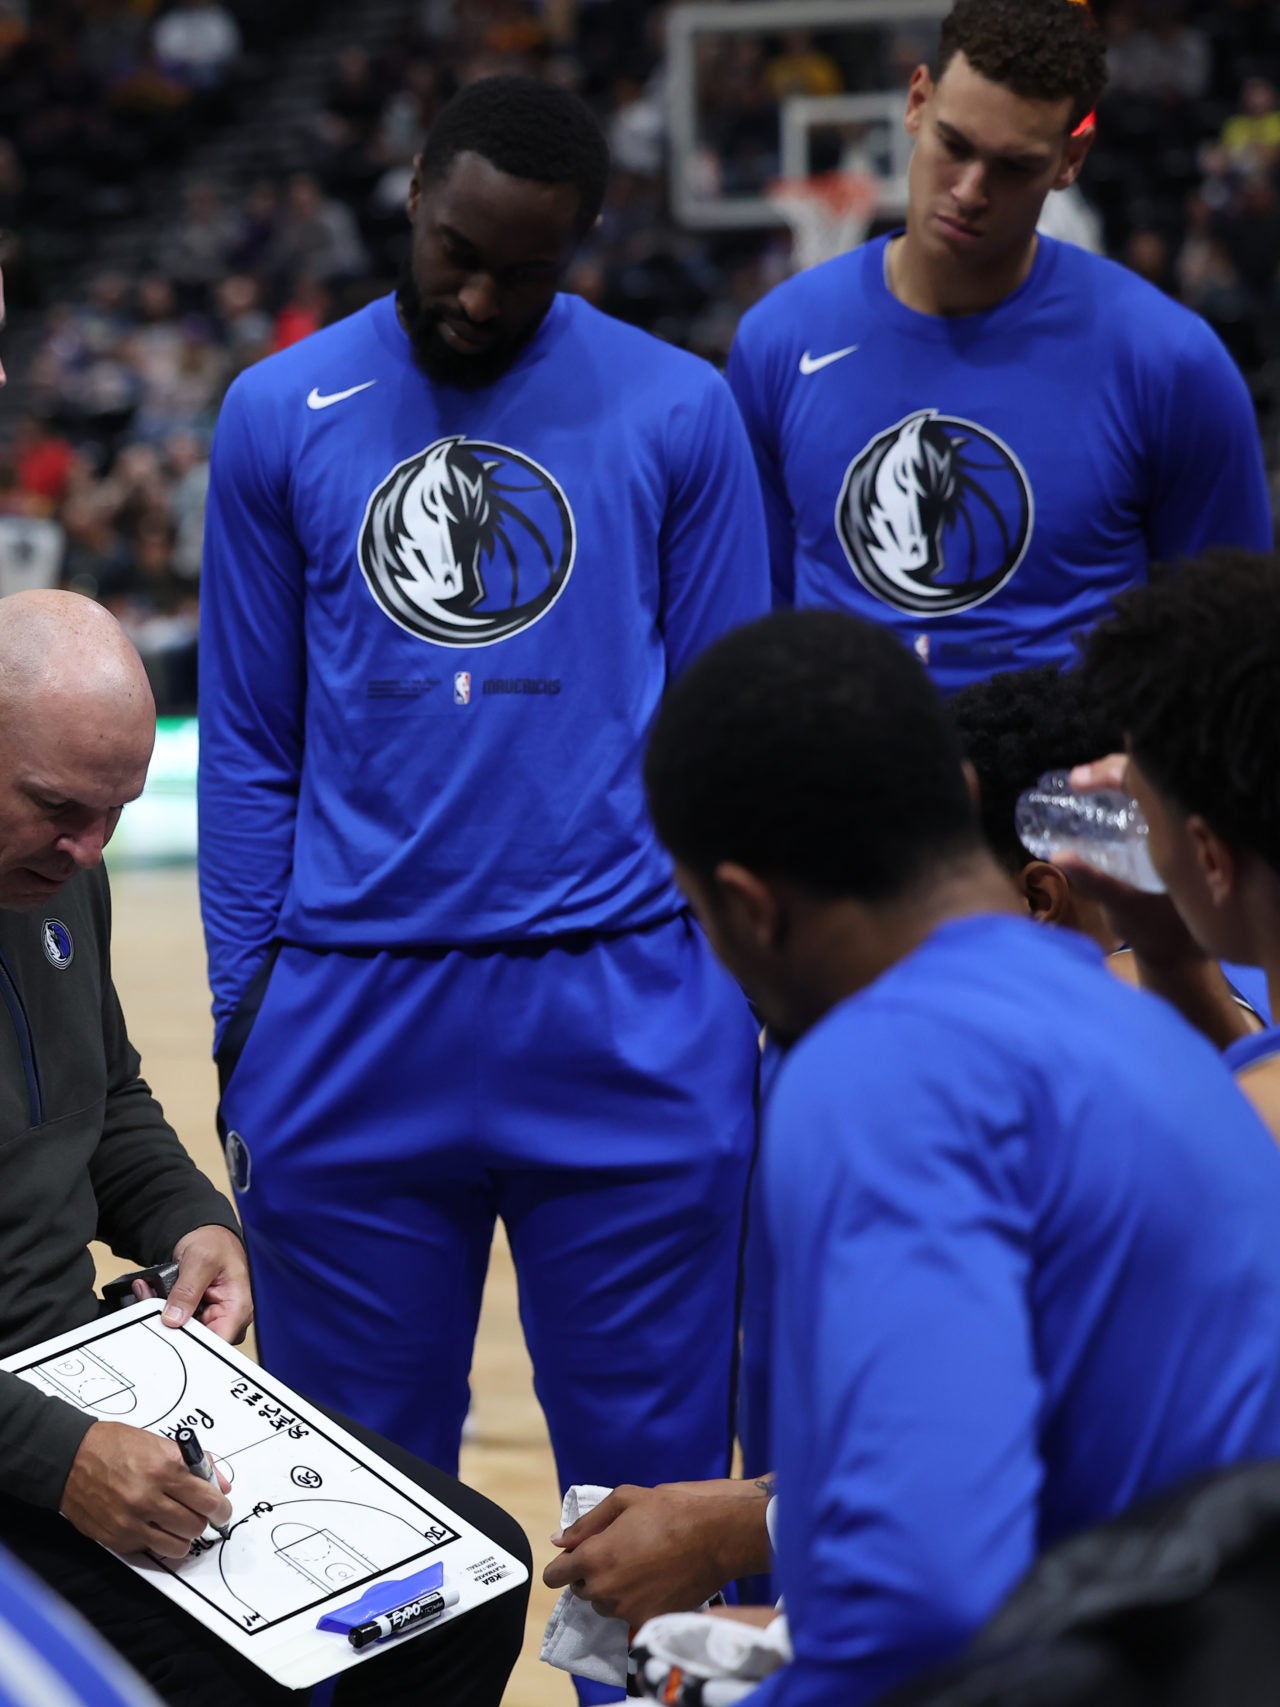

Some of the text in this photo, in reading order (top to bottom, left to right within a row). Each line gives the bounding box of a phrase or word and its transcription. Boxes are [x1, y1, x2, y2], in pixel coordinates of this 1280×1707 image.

[473, 1564, 506, 1581] PLAYMAKER
[482, 1573, 502, 1585] KBA
[392, 1603, 420, 1627] EXPO
